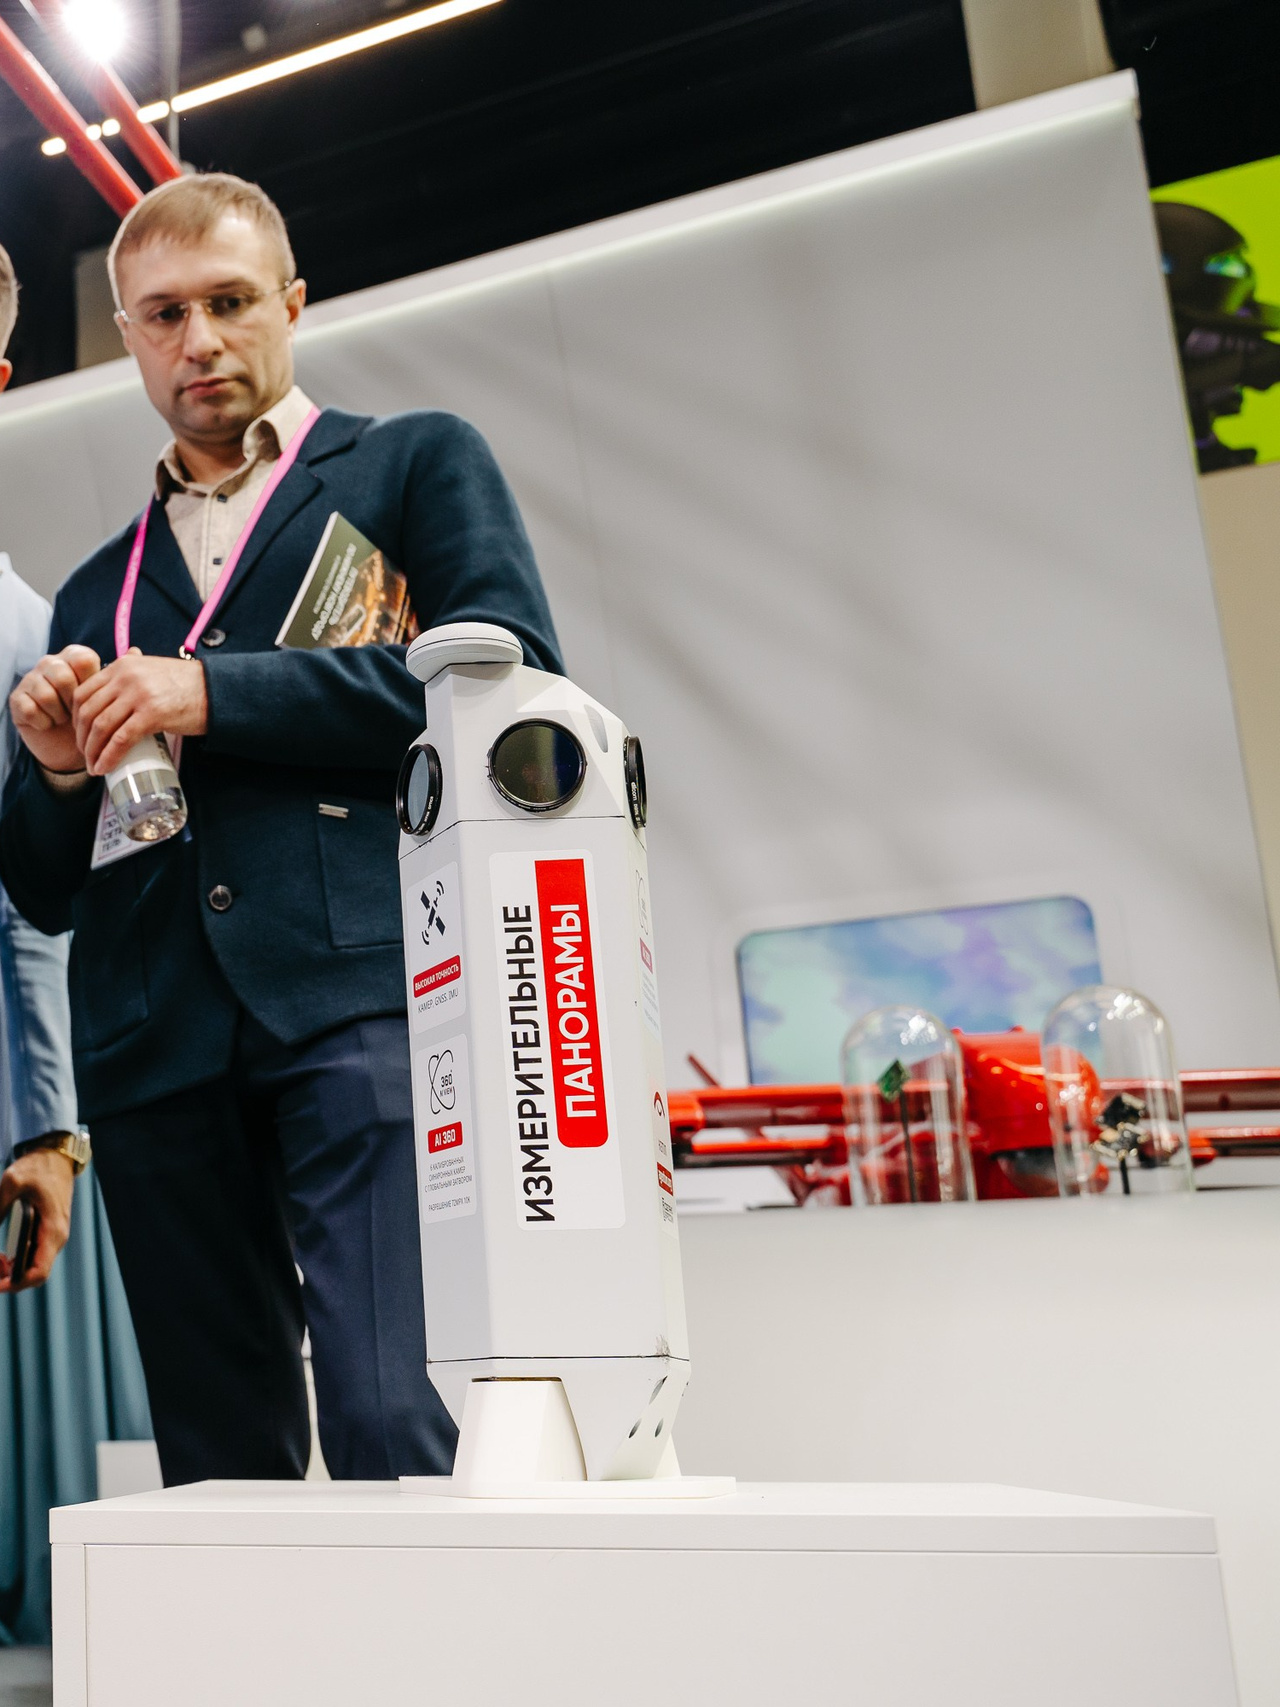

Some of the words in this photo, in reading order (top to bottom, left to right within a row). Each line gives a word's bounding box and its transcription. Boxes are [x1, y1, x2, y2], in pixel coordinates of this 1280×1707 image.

[415, 974, 436, 991] ВЫСОКАЯ
[436, 964, 459, 980] ТОЧНОСТЬ
[552, 904, 597, 1118] ПАНОРАМЫ
[503, 905, 556, 1222] ИЗМЕРИТЕЛЬНЫЕ
[434, 1132, 441, 1147] AI
[442, 1128, 456, 1145] 360
